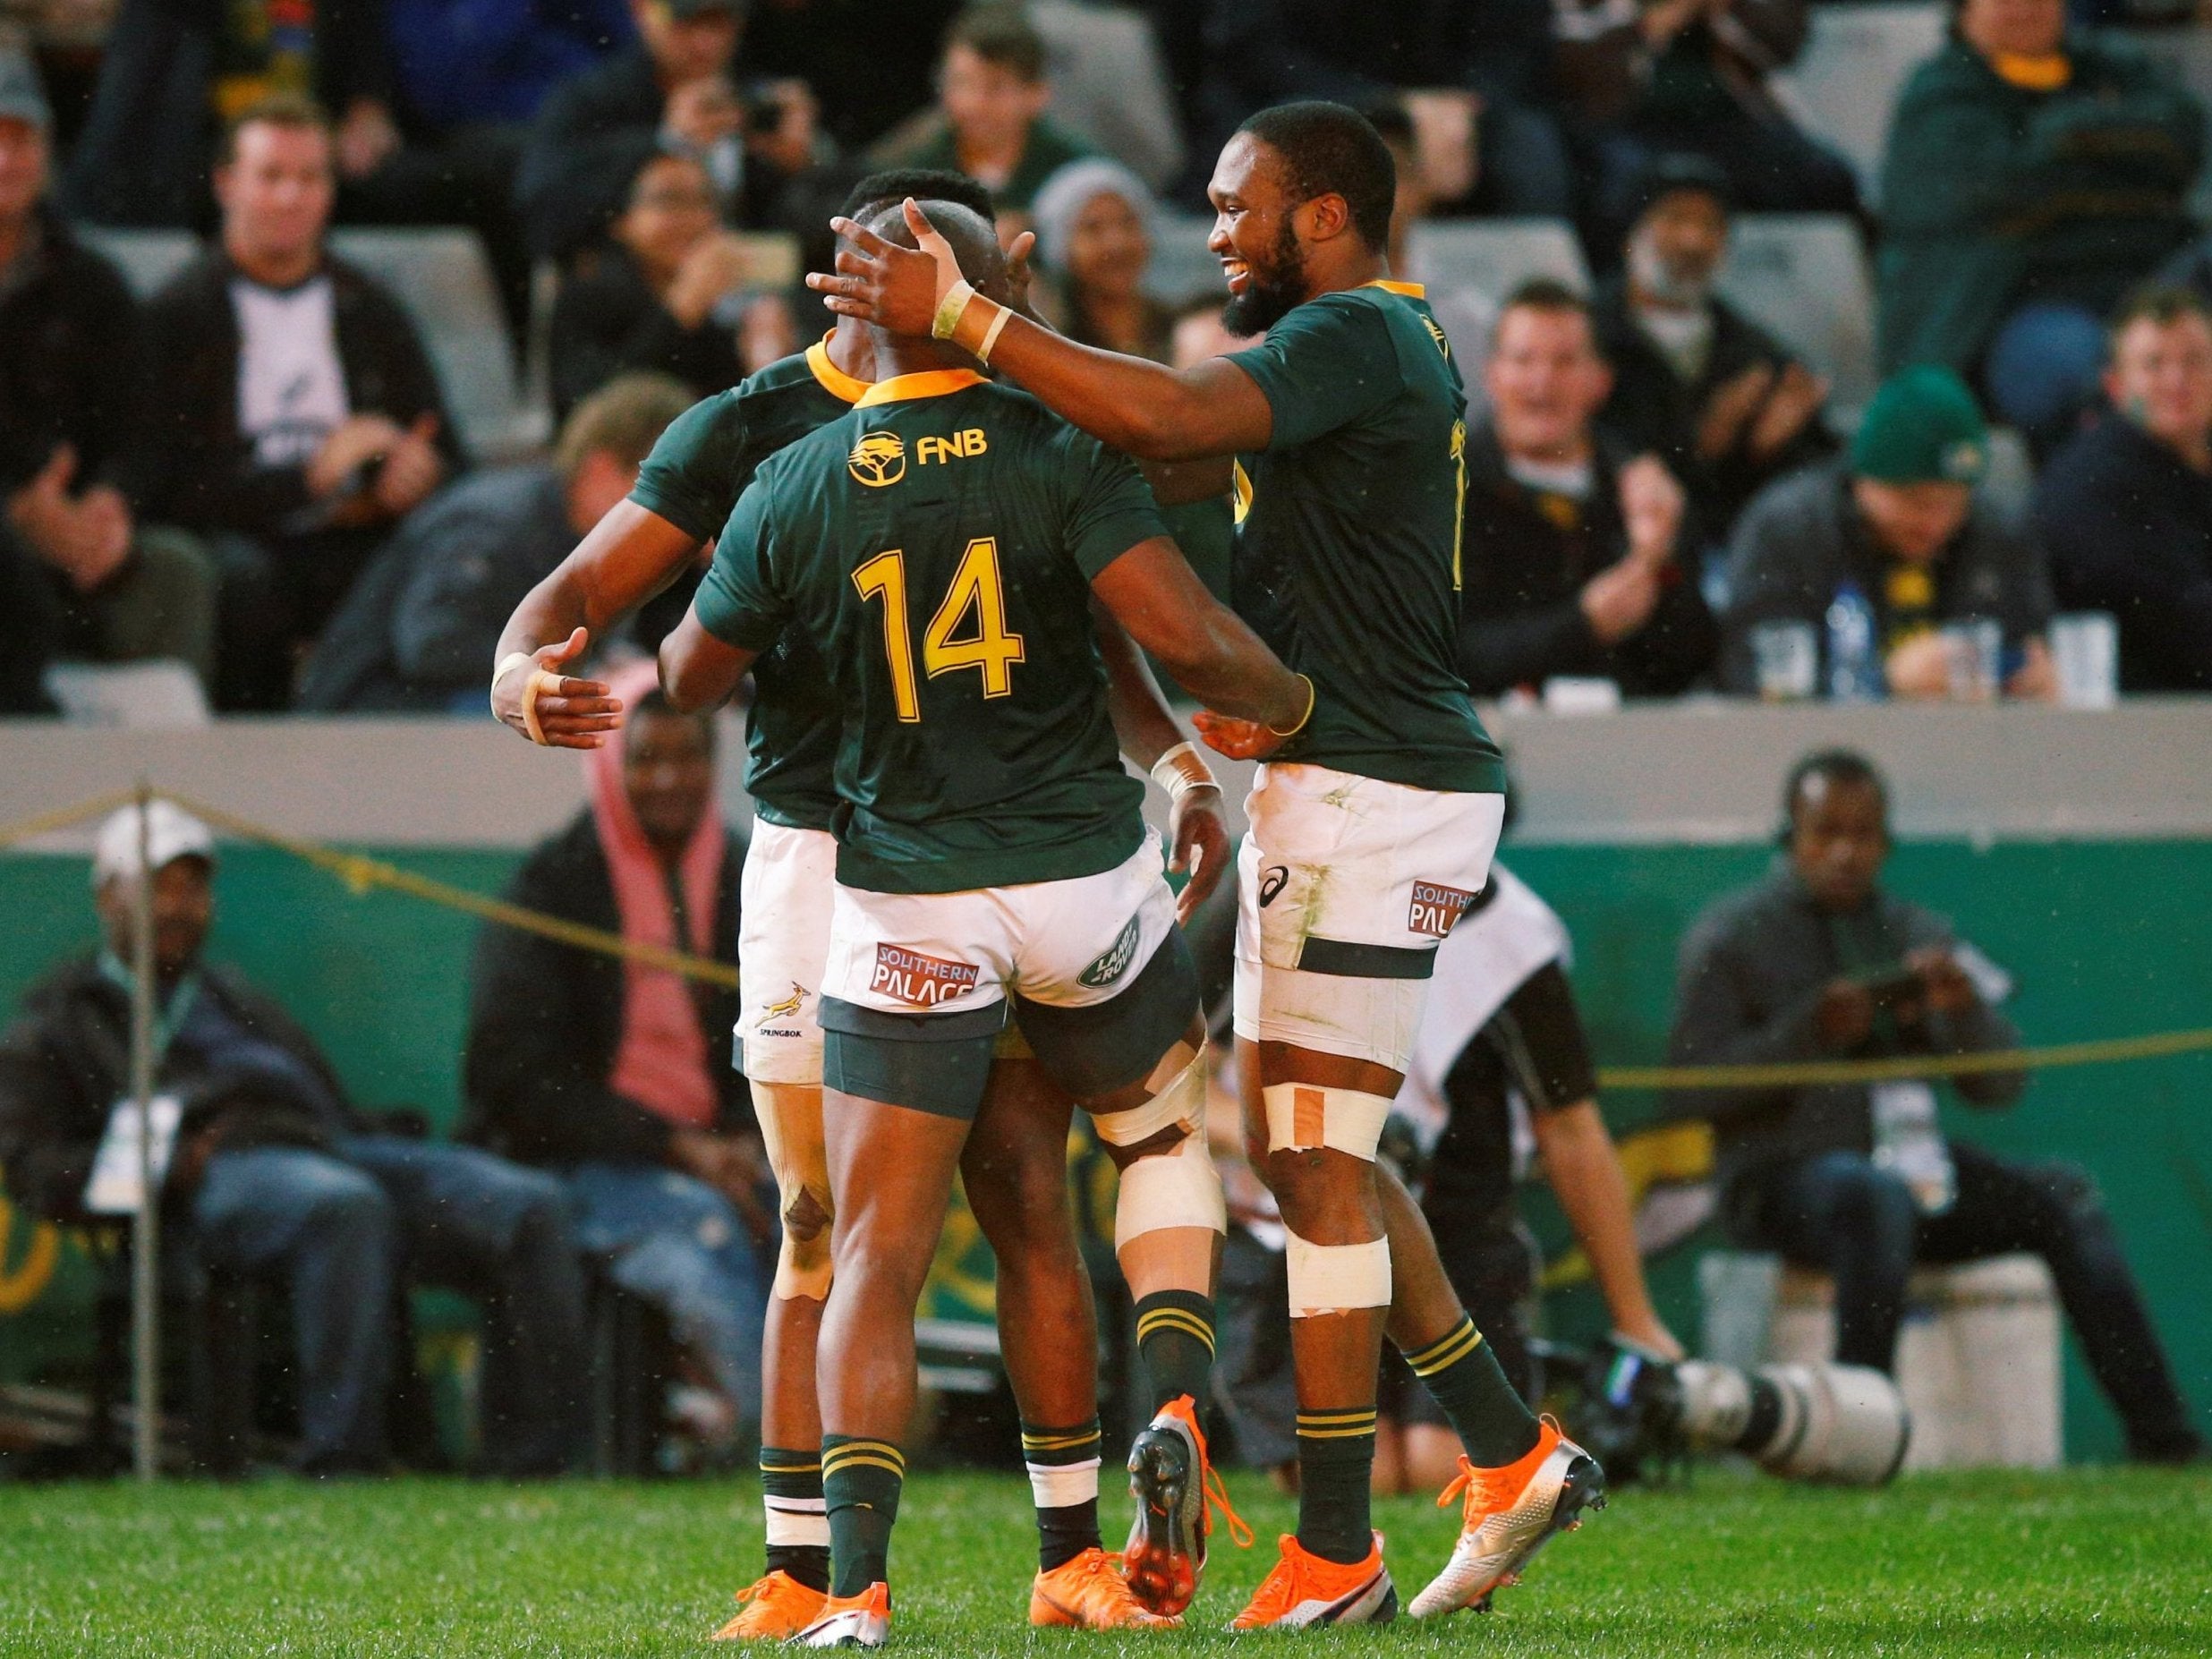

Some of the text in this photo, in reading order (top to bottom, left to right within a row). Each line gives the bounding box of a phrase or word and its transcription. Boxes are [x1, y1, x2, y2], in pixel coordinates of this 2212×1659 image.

[916, 429, 988, 464] FNB
[1450, 418, 1470, 591] 1
[851, 536, 1025, 722] 14
[878, 947, 977, 981] SOUTHERN
[760, 1028, 803, 1038] SPRINGBOK
